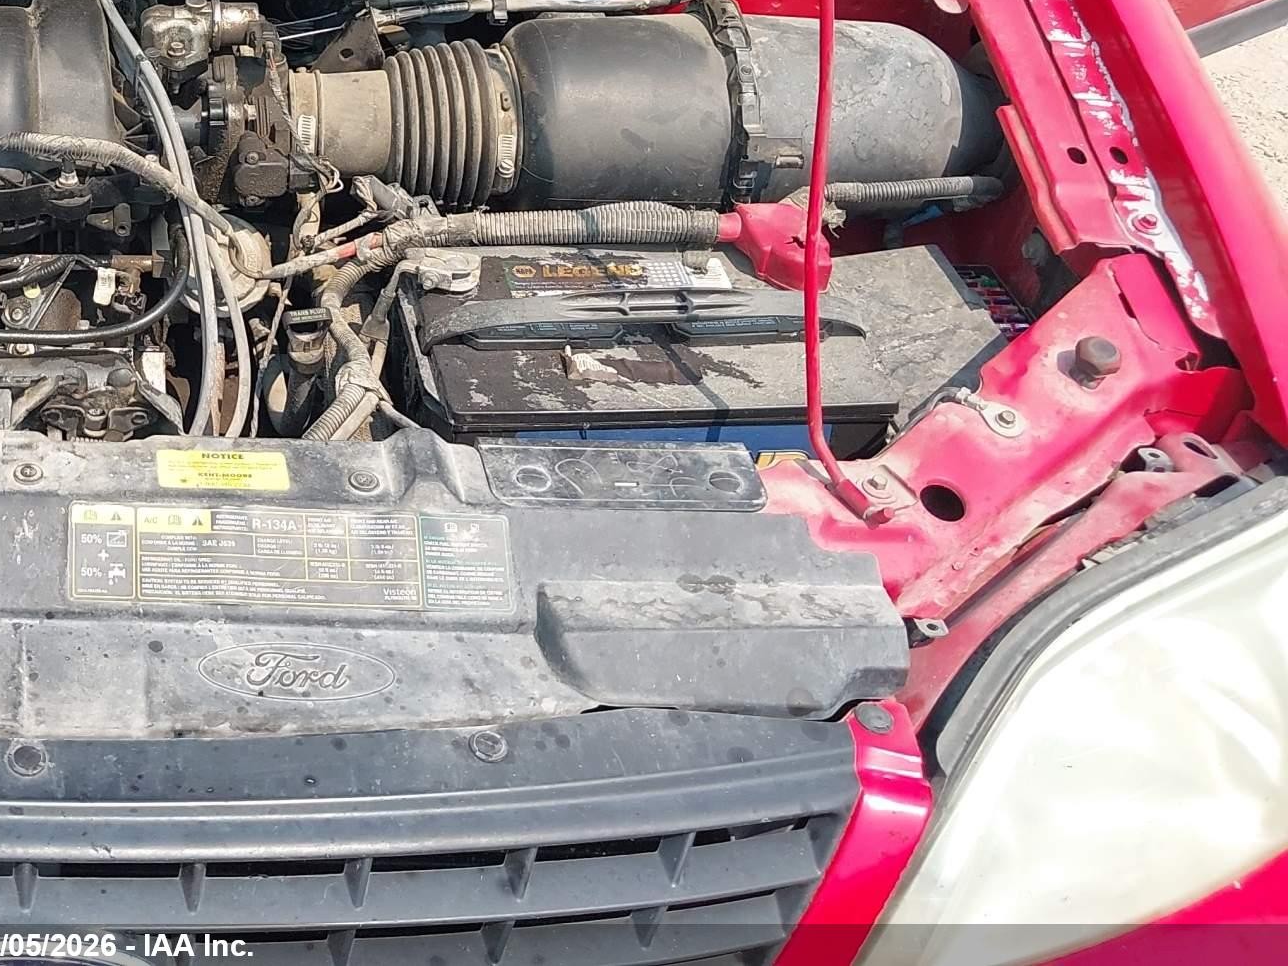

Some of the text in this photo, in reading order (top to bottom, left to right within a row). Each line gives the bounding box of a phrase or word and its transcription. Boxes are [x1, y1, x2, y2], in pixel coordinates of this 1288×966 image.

[144, 516, 158, 524] A/C
[252, 518, 297, 531] R-134A
[81, 534, 103, 545] 50%
[81, 567, 103, 577] 50%
[383, 587, 417, 596] Visteon
[246, 651, 349, 690] Ford
